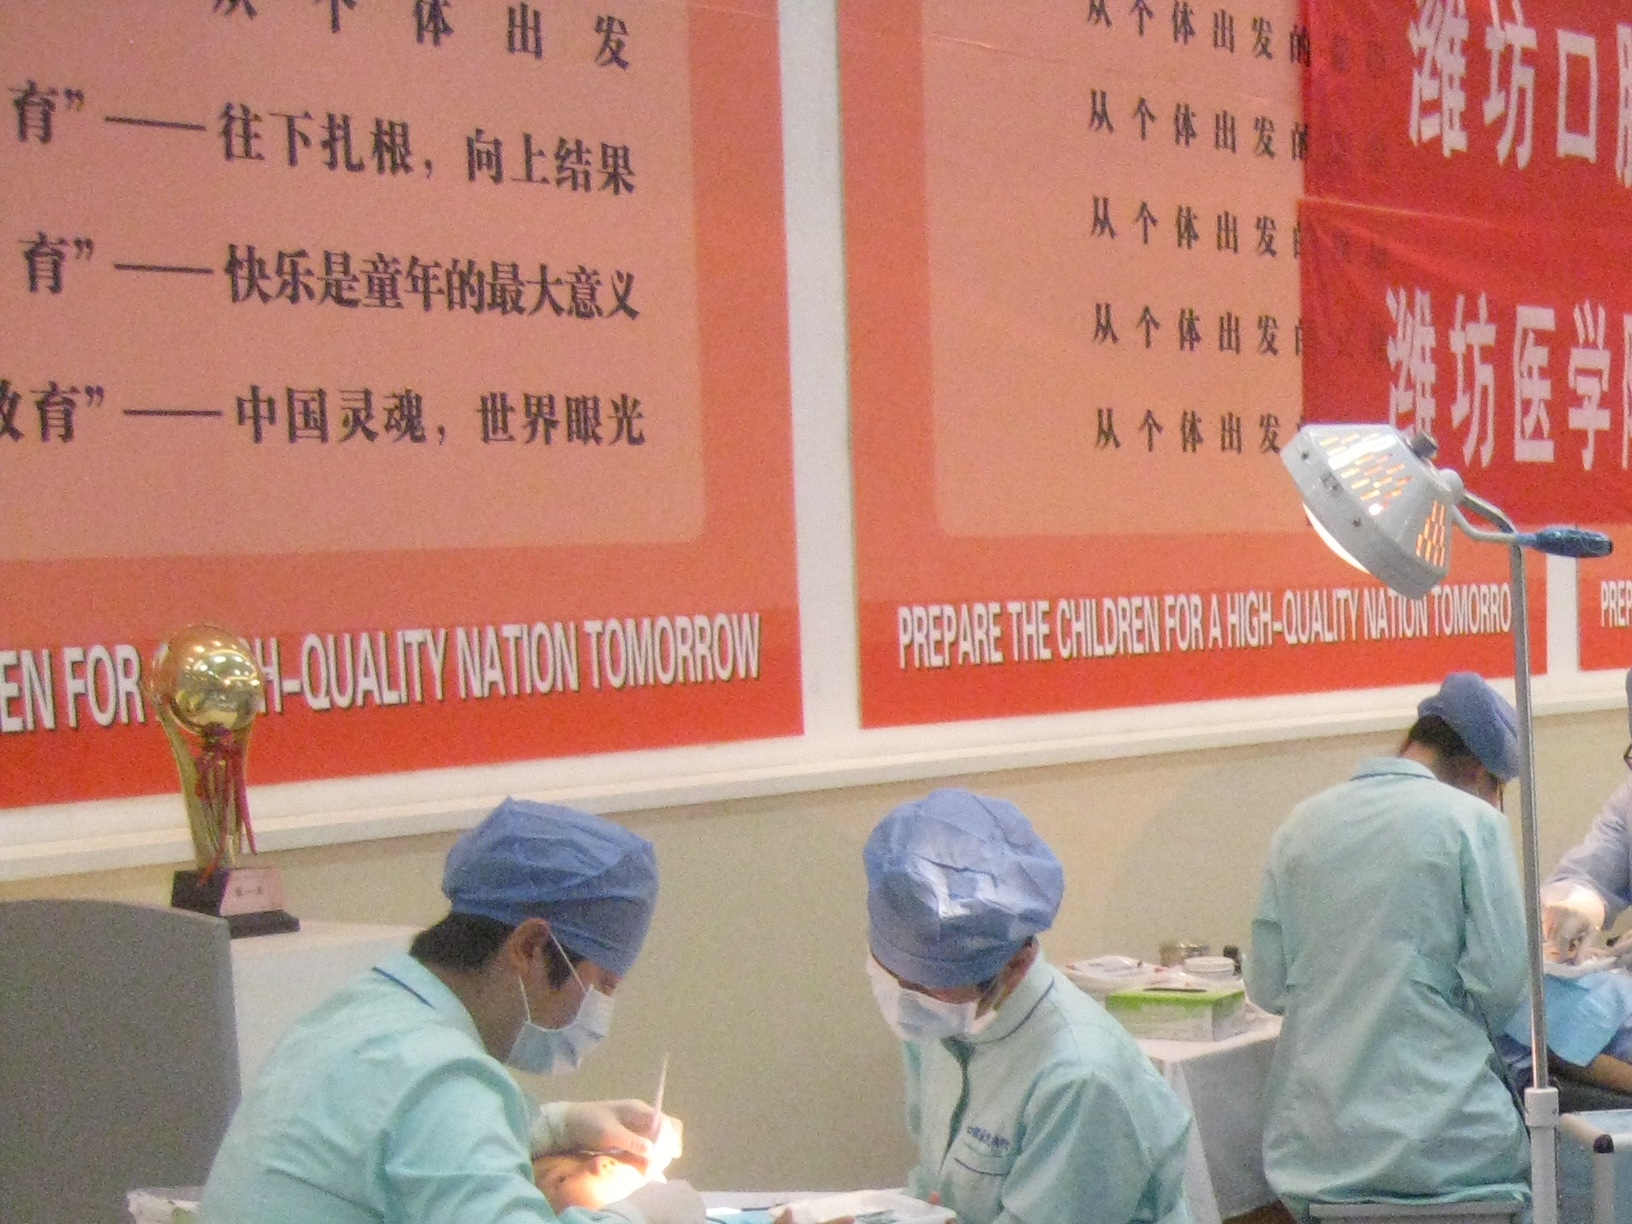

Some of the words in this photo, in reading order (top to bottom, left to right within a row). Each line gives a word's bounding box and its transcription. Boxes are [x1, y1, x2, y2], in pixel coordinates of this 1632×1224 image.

[1092, 302, 1300, 357] 从个体出发
[899, 602, 1003, 669] PREPARE
[1009, 599, 1053, 661] THE
[1057, 596, 1160, 658] CHILDREN
[1164, 594, 1204, 652] FOR
[1207, 592, 1224, 649] A
[1226, 587, 1360, 648] HIGH-QUALITY
[1363, 586, 1429, 641] NATION
[1431, 582, 1512, 637] TOMORRO
[63, 643, 147, 729] FOR
[250, 627, 447, 714] H-QUALITY
[457, 620, 580, 699] NATION
[585, 612, 762, 690] TOMORROW
